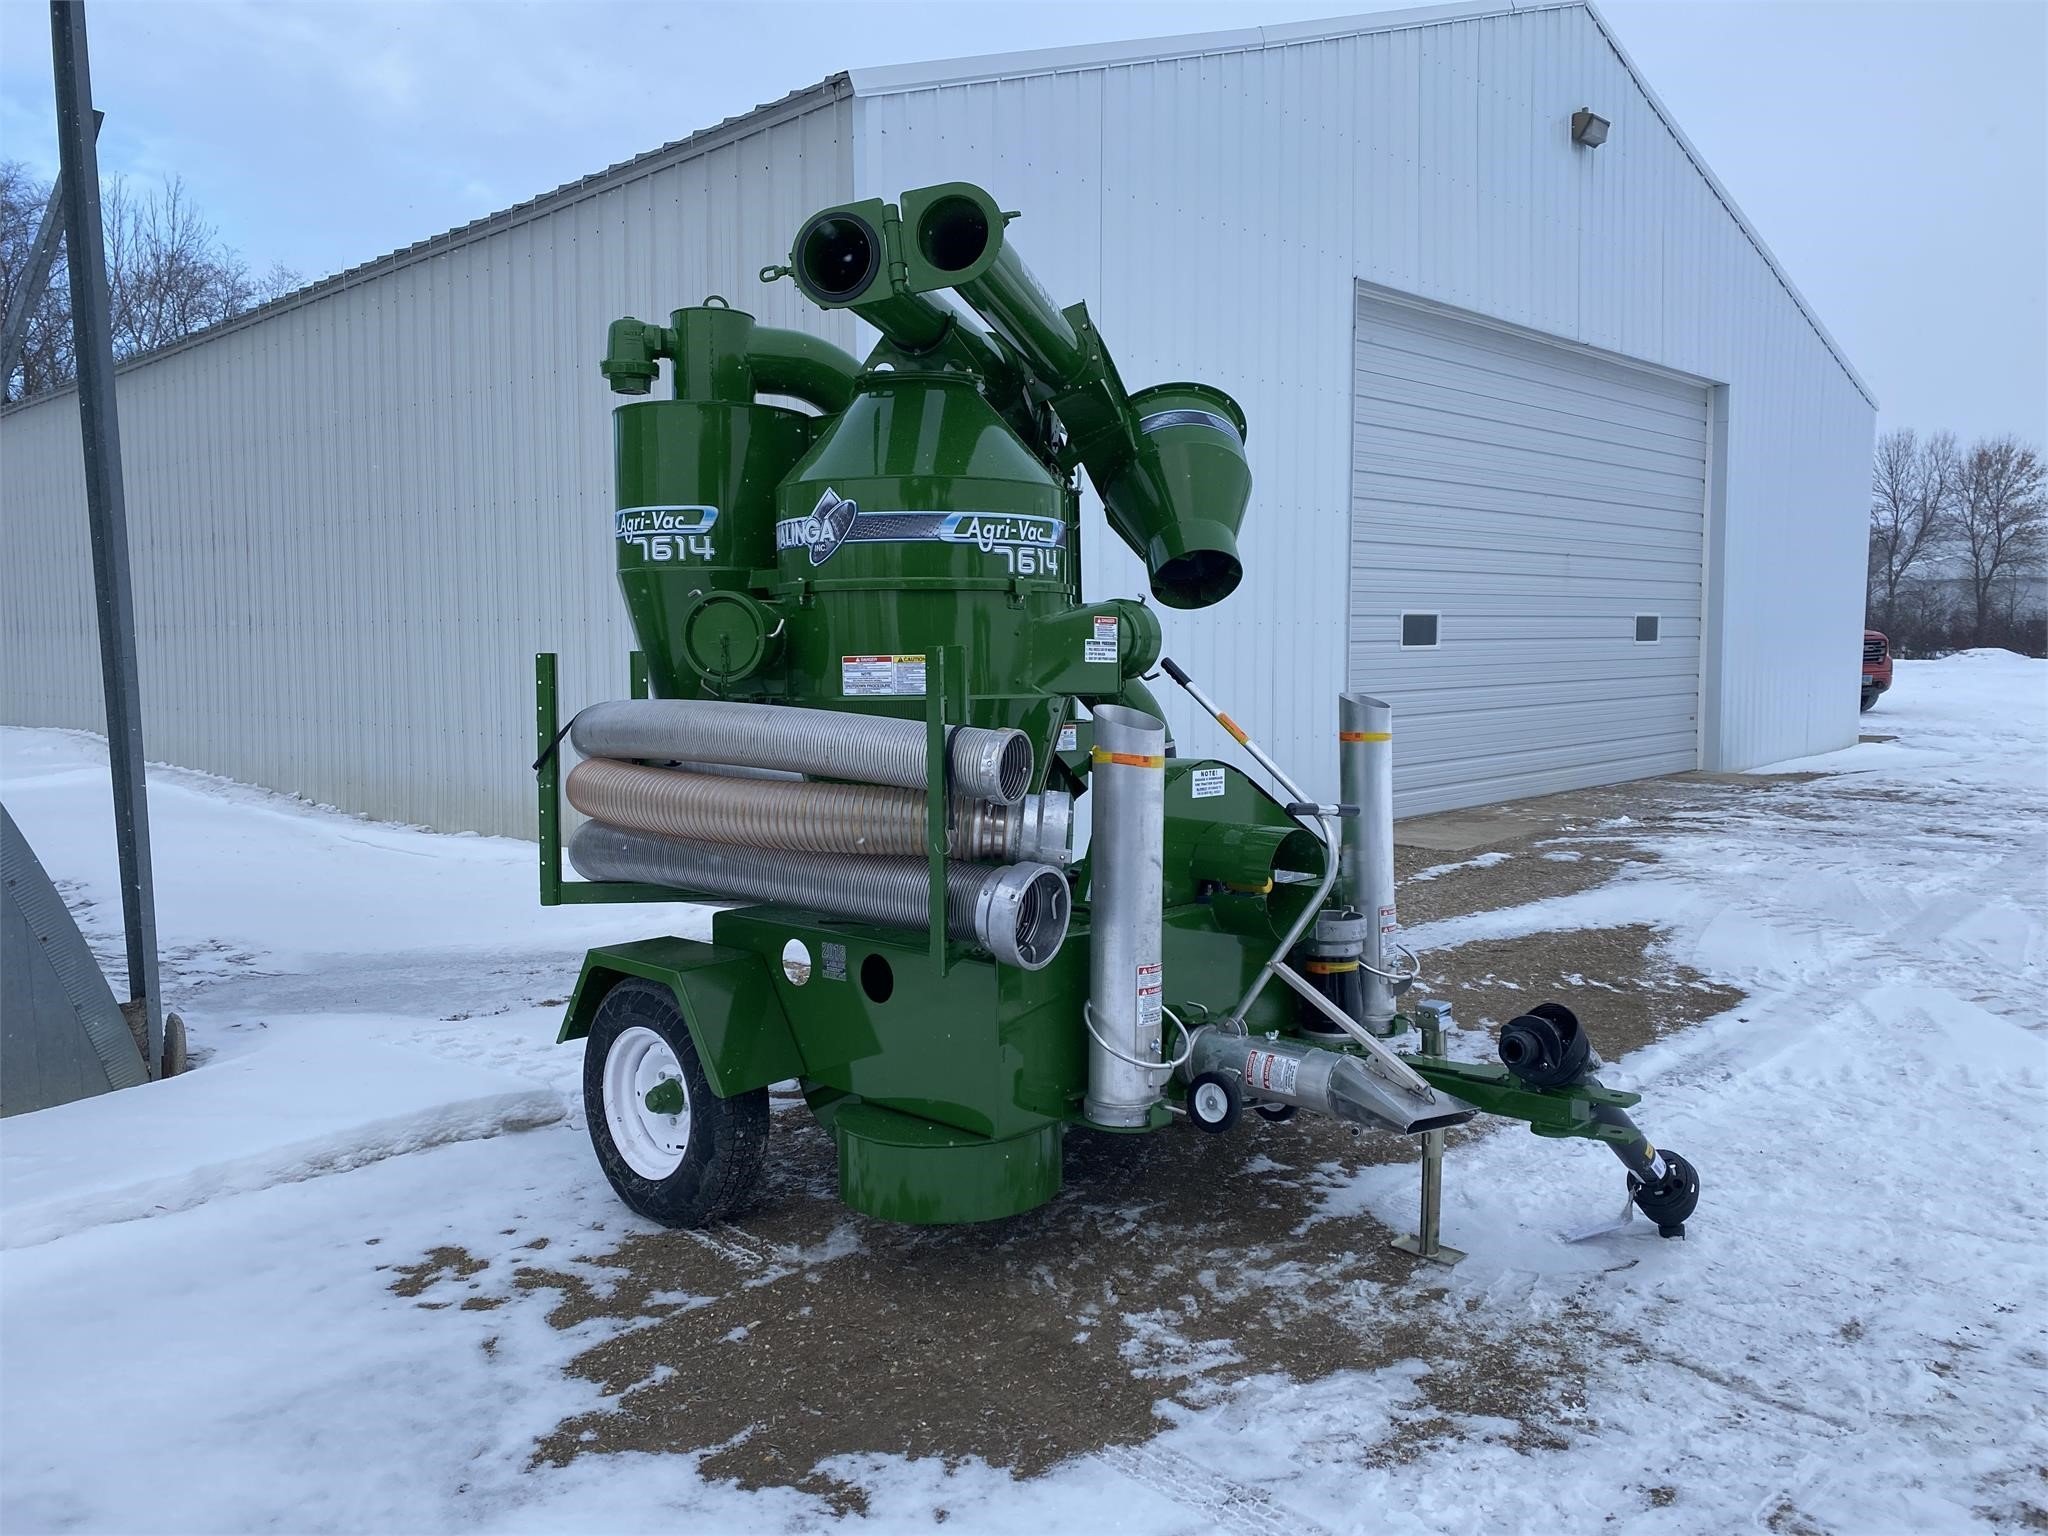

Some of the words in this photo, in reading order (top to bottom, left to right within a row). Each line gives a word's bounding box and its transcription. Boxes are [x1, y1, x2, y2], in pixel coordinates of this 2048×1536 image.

[618, 511, 685, 544] Agri-Vac
[777, 518, 836, 549] ALINGA
[966, 517, 1044, 552] Agri-Vac
[632, 535, 715, 561] 7614
[993, 545, 1058, 575] 7614
